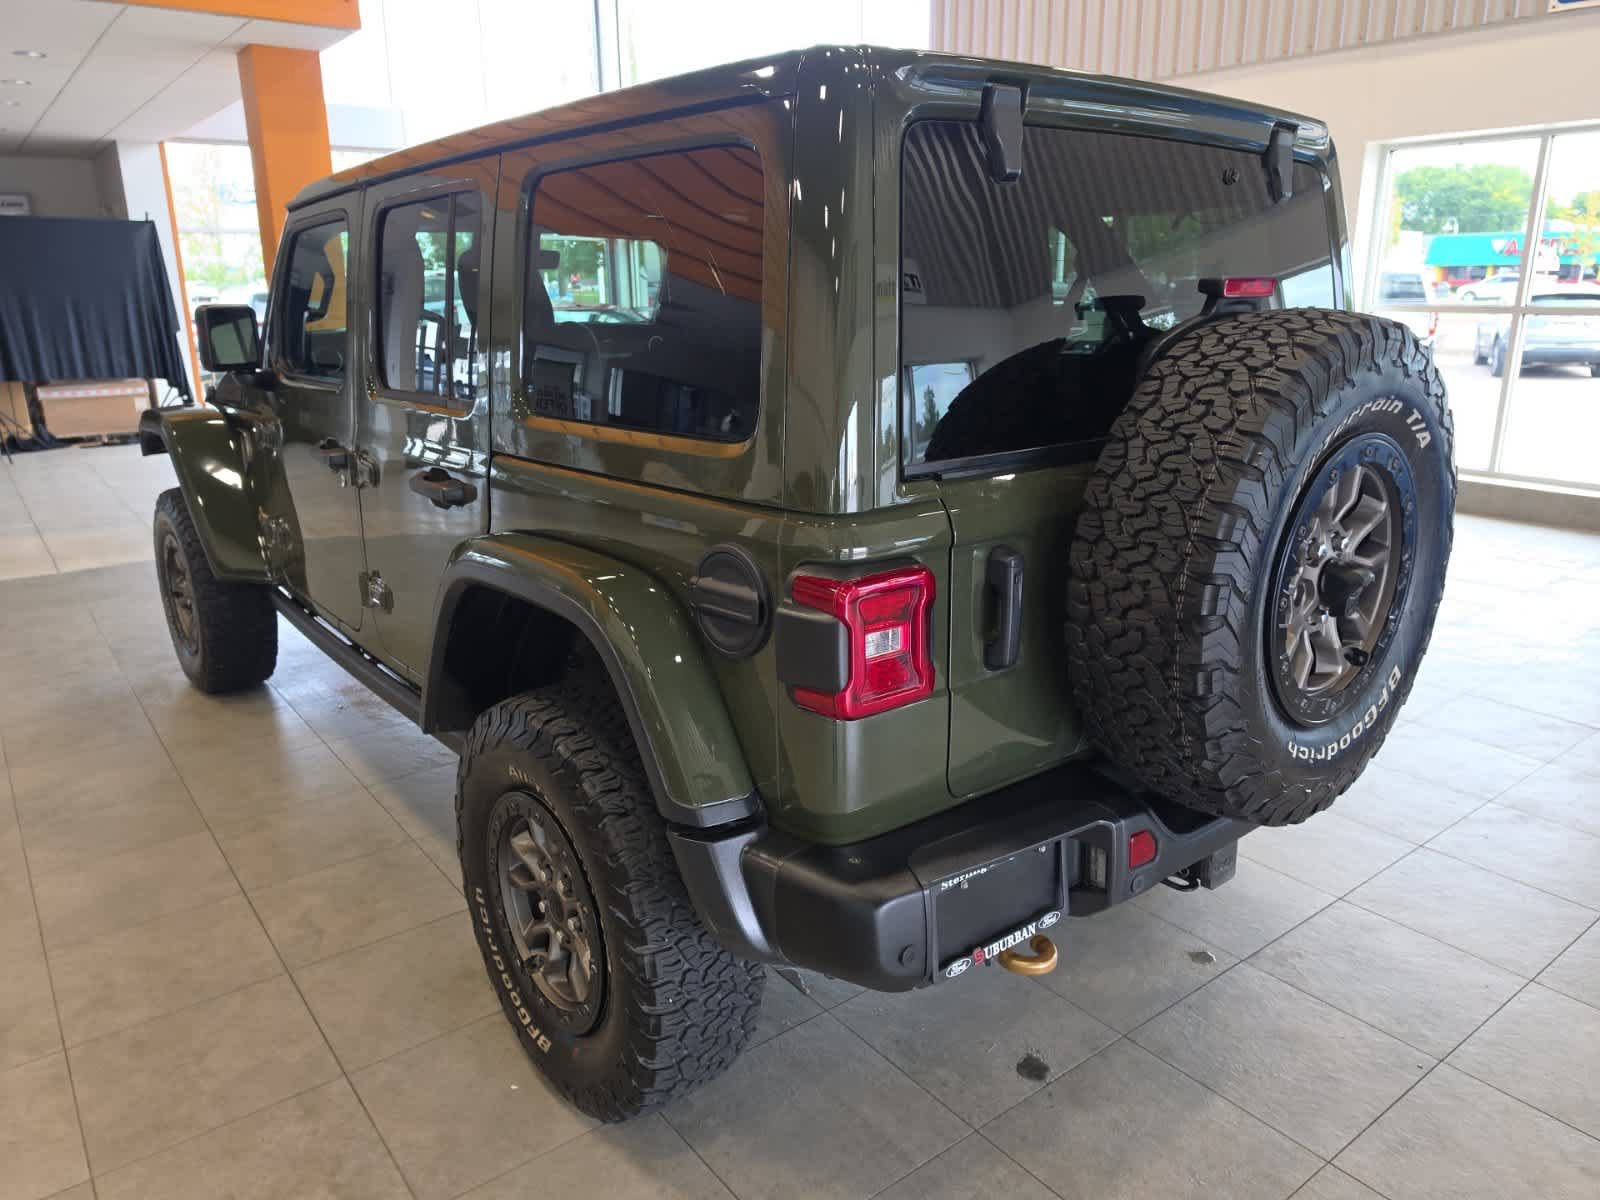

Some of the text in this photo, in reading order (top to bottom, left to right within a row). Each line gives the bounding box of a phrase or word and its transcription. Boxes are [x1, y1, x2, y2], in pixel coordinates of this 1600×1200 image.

[1406, 408, 1432, 449] T/A
[1288, 664, 1401, 764] BFGoodrich
[475, 887, 552, 1053] BFGoodrich
[972, 922, 1036, 966] SUBURBAN
